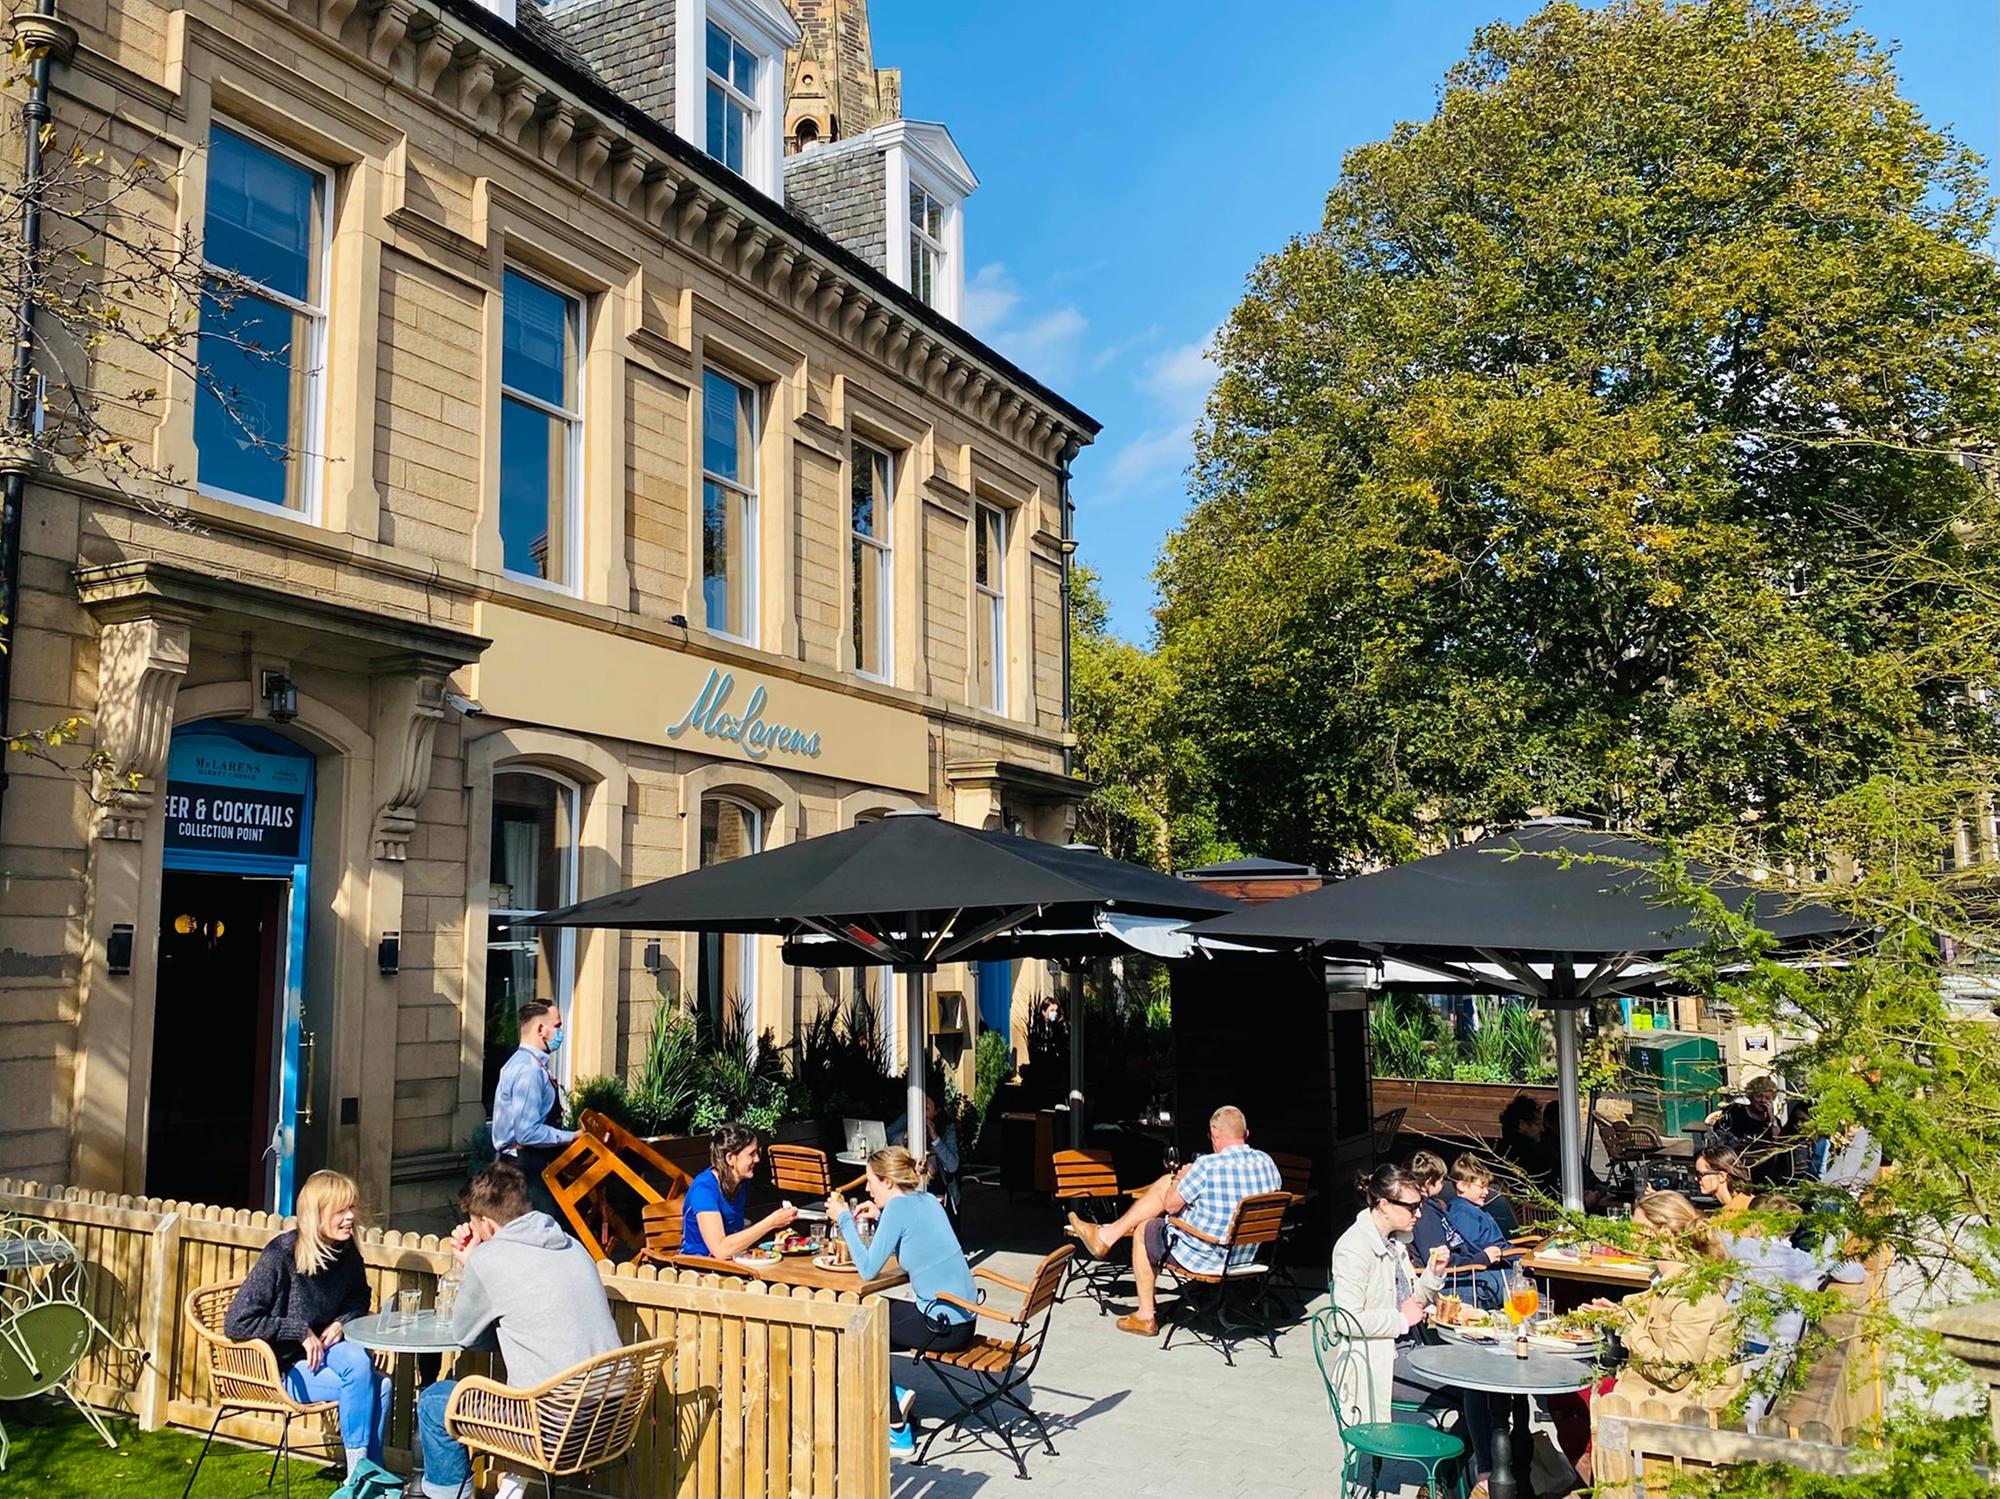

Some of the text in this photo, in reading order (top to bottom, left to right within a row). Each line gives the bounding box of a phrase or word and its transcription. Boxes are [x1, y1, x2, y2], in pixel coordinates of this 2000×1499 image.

[665, 666, 821, 759] McLarens
[196, 757, 261, 774] McLARENS
[195, 798, 206, 820] &
[213, 800, 294, 828] COCKTAILS
[178, 822, 264, 842] COLLECTION POINT
